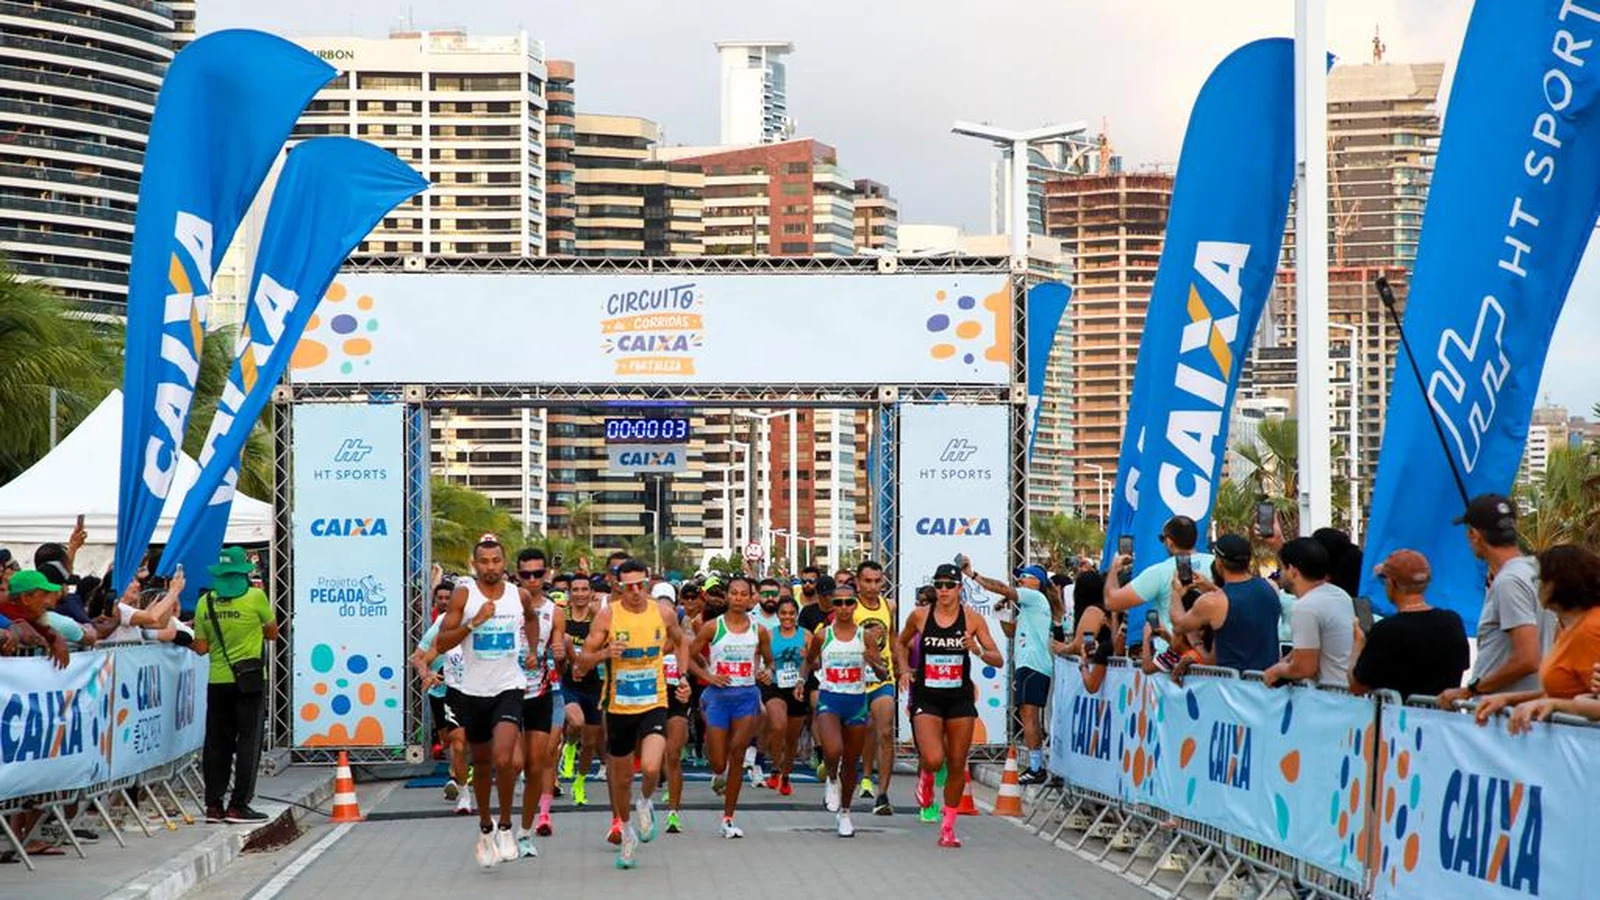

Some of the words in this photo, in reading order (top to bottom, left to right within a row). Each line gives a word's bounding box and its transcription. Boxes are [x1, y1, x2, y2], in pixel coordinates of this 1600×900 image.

[1498, 198, 1540, 277] HT
[1524, 0, 1600, 184] SPORT
[607, 283, 696, 315] CIRCUITO
[633, 316, 689, 330] CORRIDAS
[617, 335, 689, 352] CAIXA
[143, 210, 213, 499] CAIXA
[1158, 240, 1251, 522] CAIXA
[619, 452, 676, 466] CAIXA
[314, 470, 331, 480] HT
[335, 469, 387, 480] SPORTS
[919, 469, 936, 479] HT
[941, 469, 992, 480] SPORTS
[310, 518, 388, 537] CAIXA
[916, 517, 991, 536] CAIXA
[318, 576, 359, 589] Projeto
[310, 588, 364, 604] PEGADA
[339, 603, 355, 617] do
[360, 602, 388, 617] bem
[1, 689, 83, 764] CAIXA
[1072, 696, 1111, 761] CAIXA
[1209, 720, 1251, 791] CAIXA
[1439, 769, 1542, 896] CAIXA
